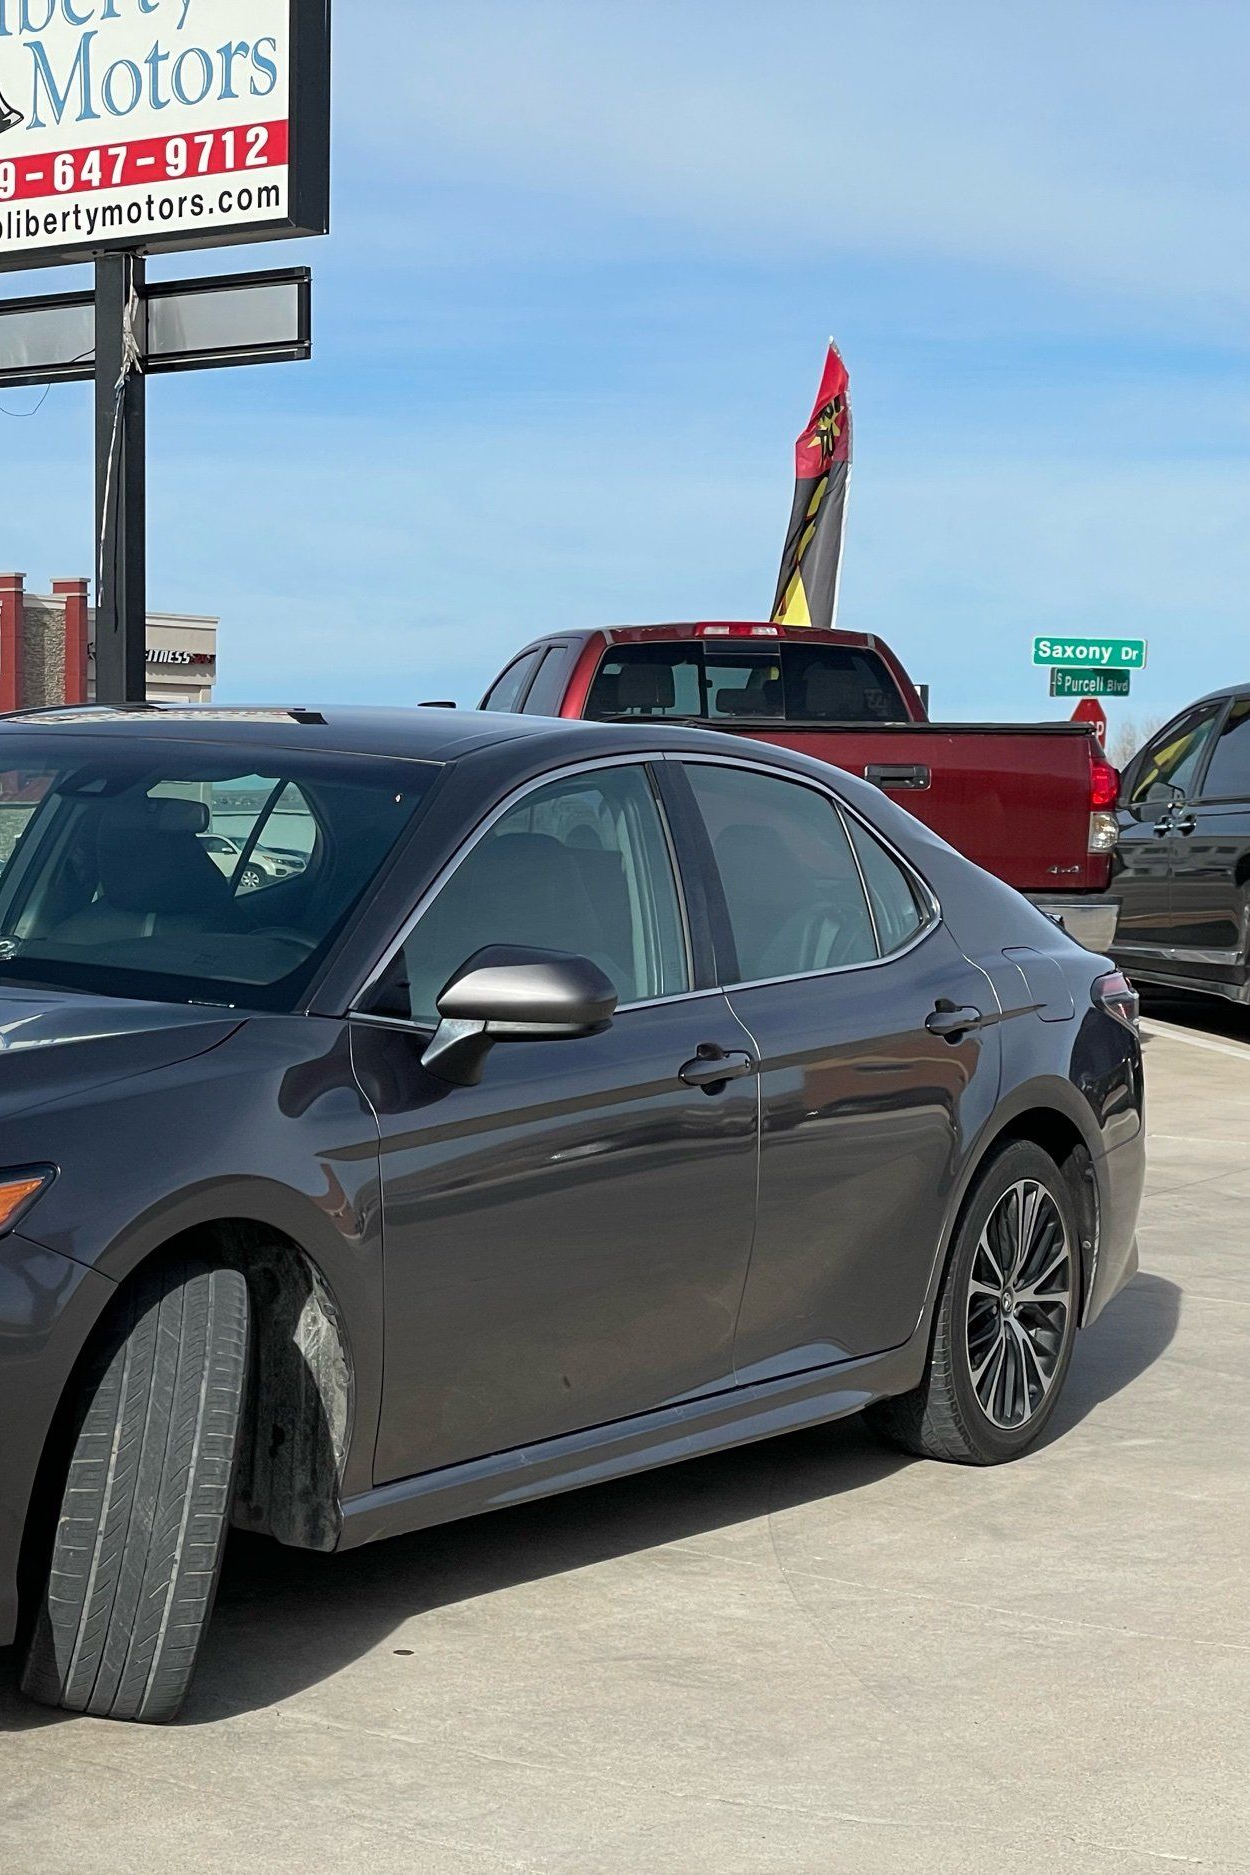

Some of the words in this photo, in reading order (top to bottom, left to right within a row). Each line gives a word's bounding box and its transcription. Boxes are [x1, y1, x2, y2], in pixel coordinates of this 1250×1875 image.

[23, 30, 278, 130] Motors
[144, 649, 190, 664] ITNESS
[1038, 640, 1113, 664] Saxony
[1121, 646, 1139, 660] Dr
[1057, 672, 1063, 685] S
[1064, 675, 1104, 692] Purcell
[1106, 679, 1129, 692] Blvd
